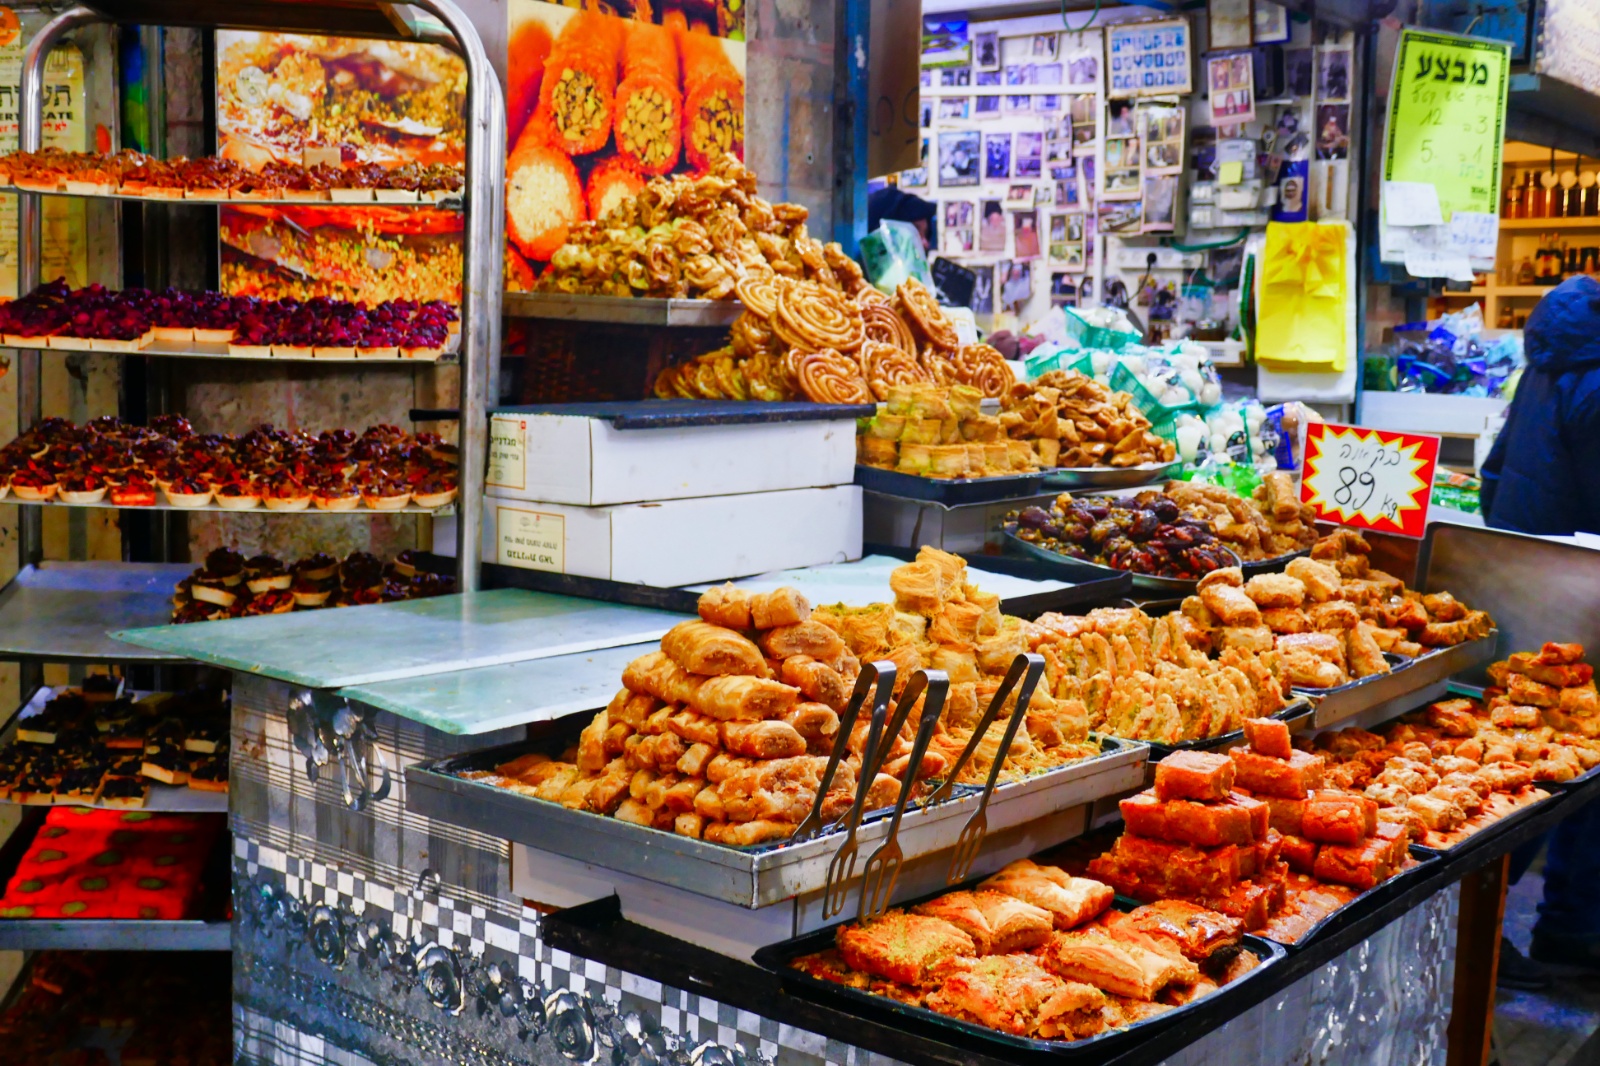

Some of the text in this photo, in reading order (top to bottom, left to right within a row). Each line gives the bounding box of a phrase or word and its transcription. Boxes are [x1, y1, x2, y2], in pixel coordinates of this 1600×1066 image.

[1414, 52, 1488, 85] מבצע
[1419, 108, 1442, 126] 12
[1475, 115, 1488, 134] 3
[1334, 466, 1375, 510] 89
